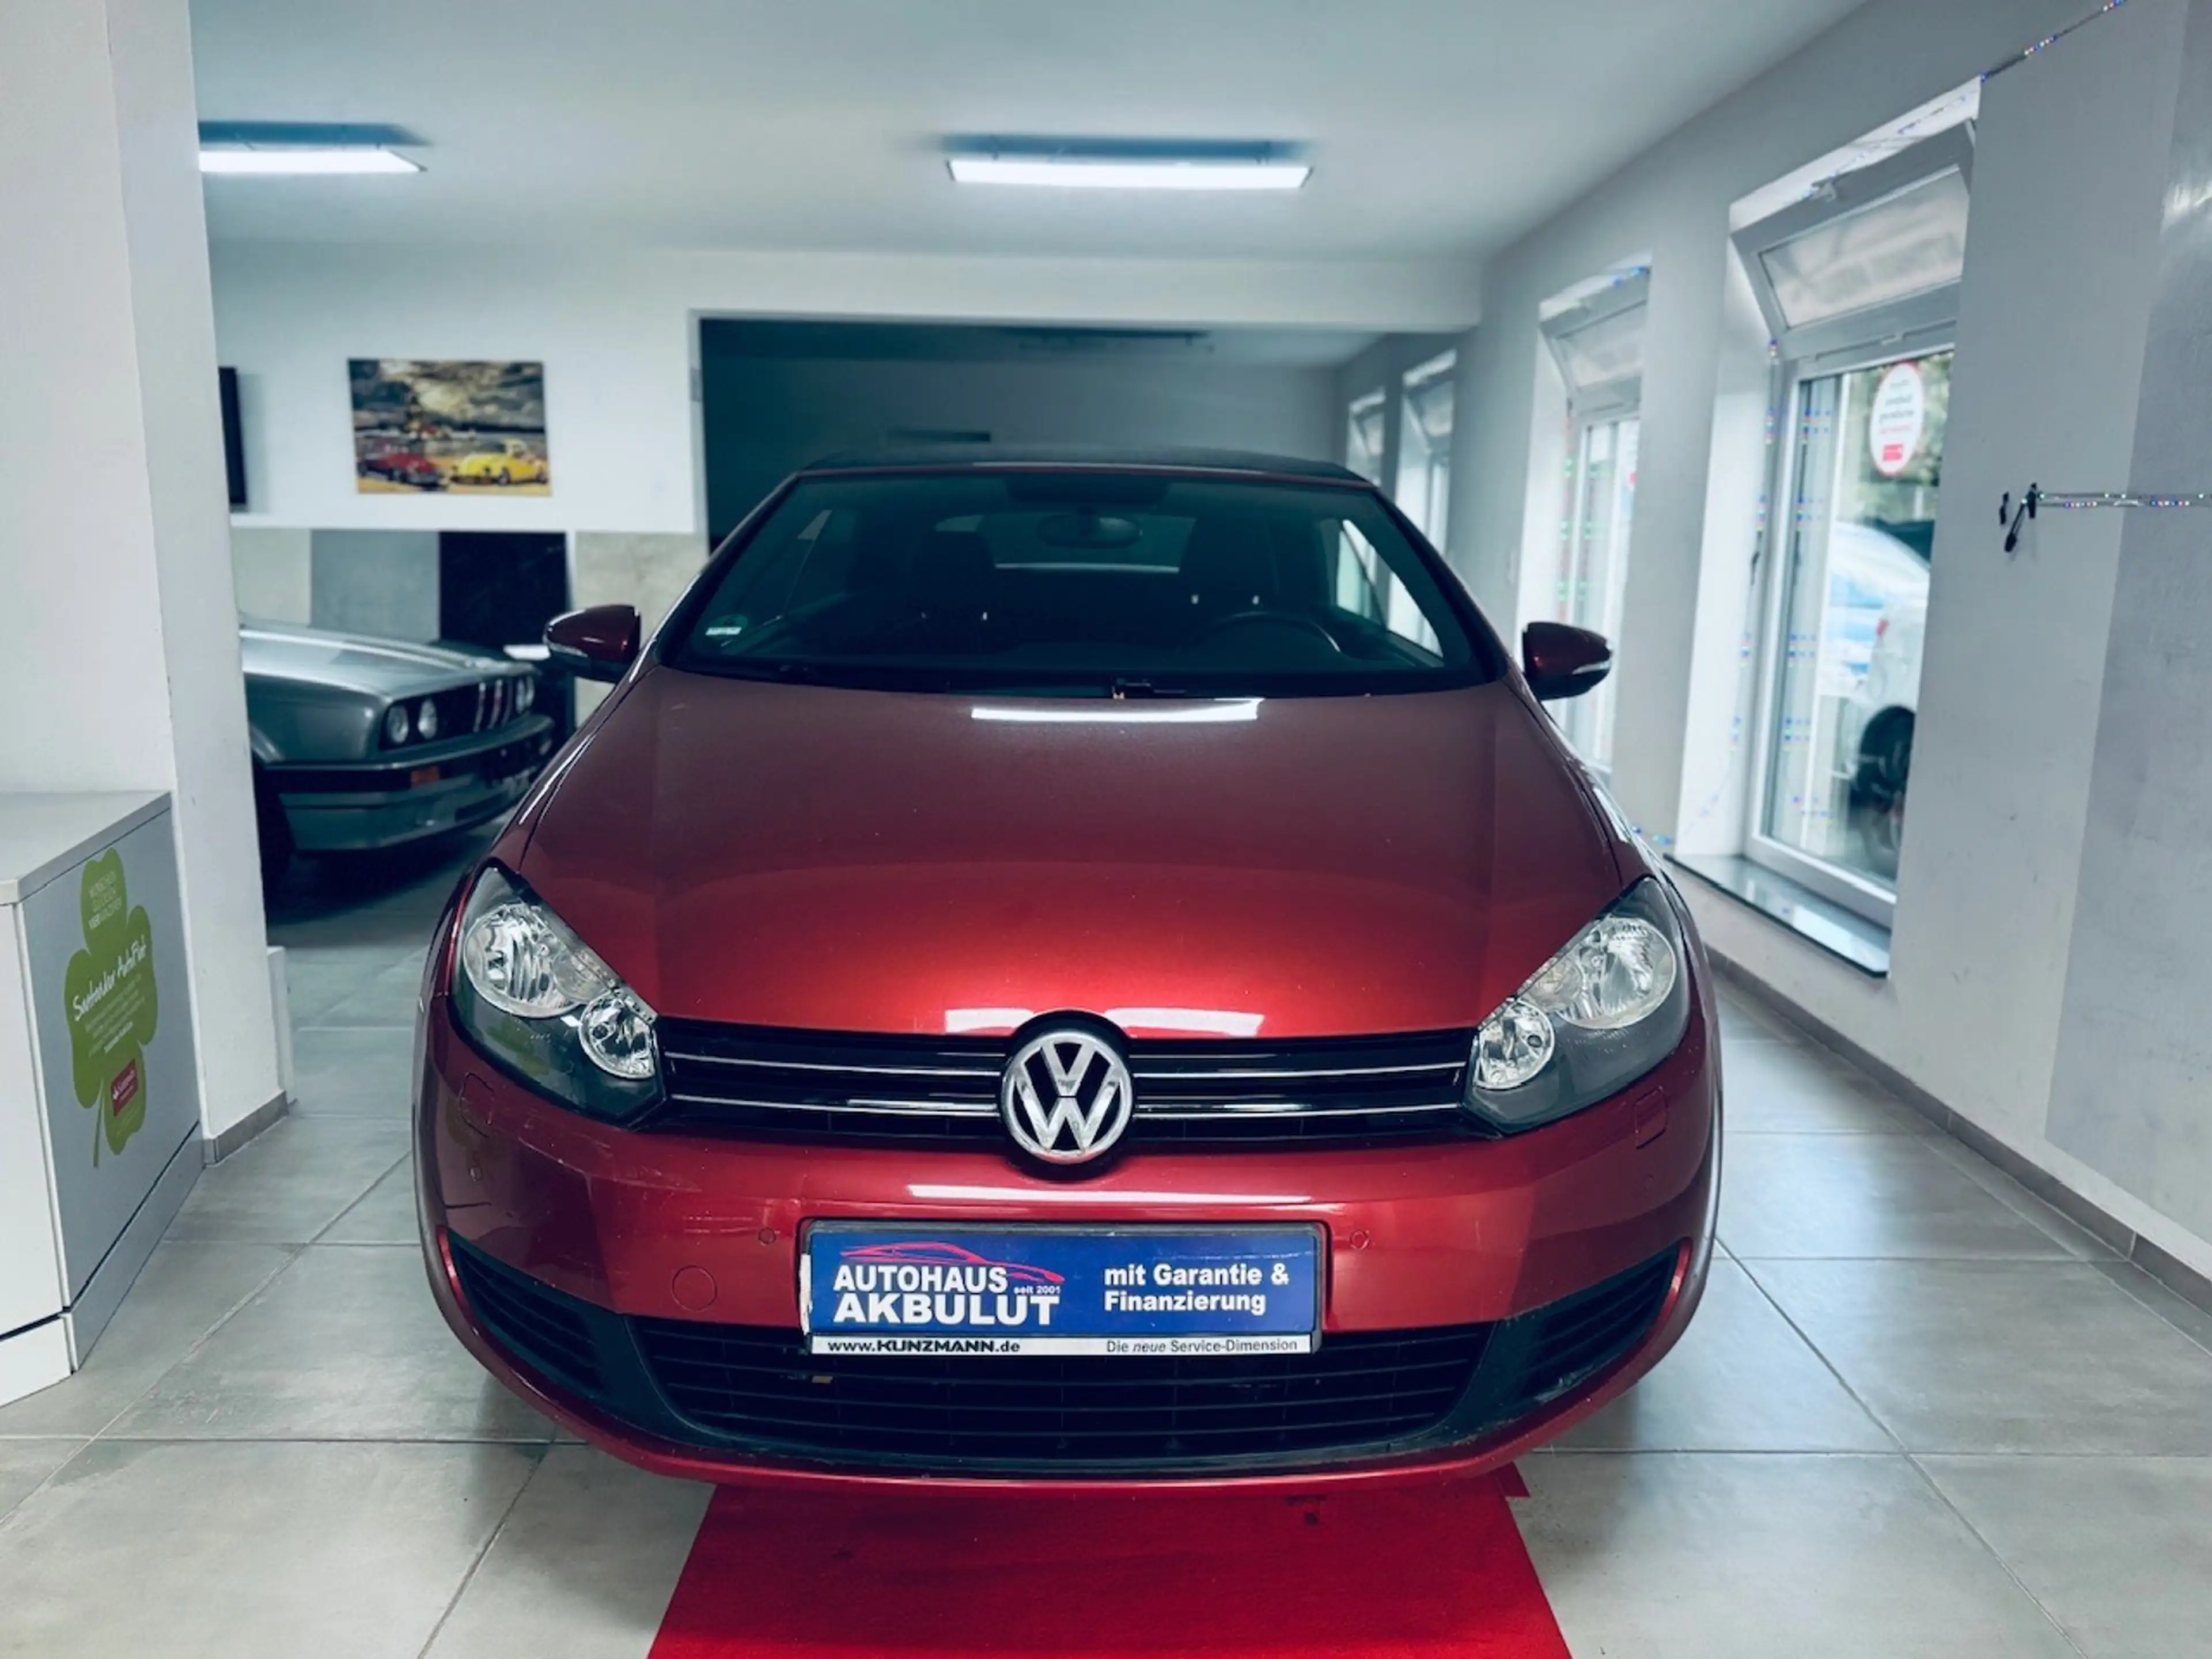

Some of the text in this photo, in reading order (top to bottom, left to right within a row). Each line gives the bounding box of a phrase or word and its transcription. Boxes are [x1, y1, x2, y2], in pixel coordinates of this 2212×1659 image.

[833, 1264, 1008, 1293] AUTOHAUS
[1104, 1263, 1290, 1286] mit Garantie &
[1013, 1285, 1061, 1294] seit 2001
[833, 1293, 1060, 1325] AKBULUT
[1104, 1290, 1267, 1316] Finanzierung
[828, 1339, 1020, 1353] www.KUNZMANN.de
[1107, 1339, 1297, 1353] Die neue Service-Dimension
